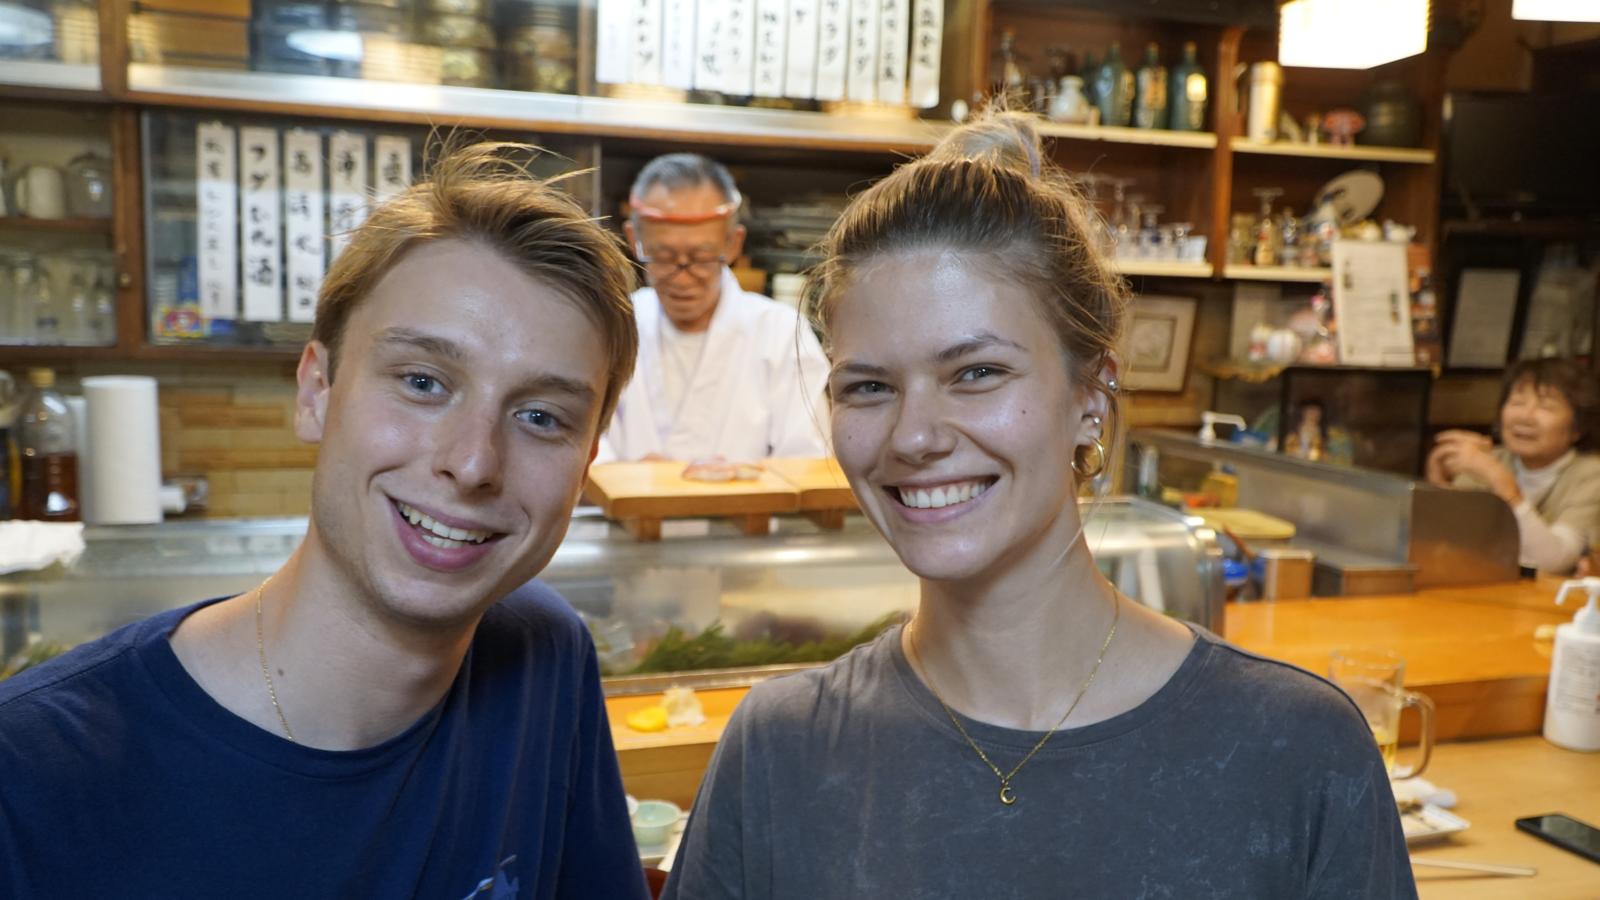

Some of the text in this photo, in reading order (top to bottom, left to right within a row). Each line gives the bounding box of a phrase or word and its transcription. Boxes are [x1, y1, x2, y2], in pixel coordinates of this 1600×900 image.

[249, 144, 274, 287] フグひれ酒
